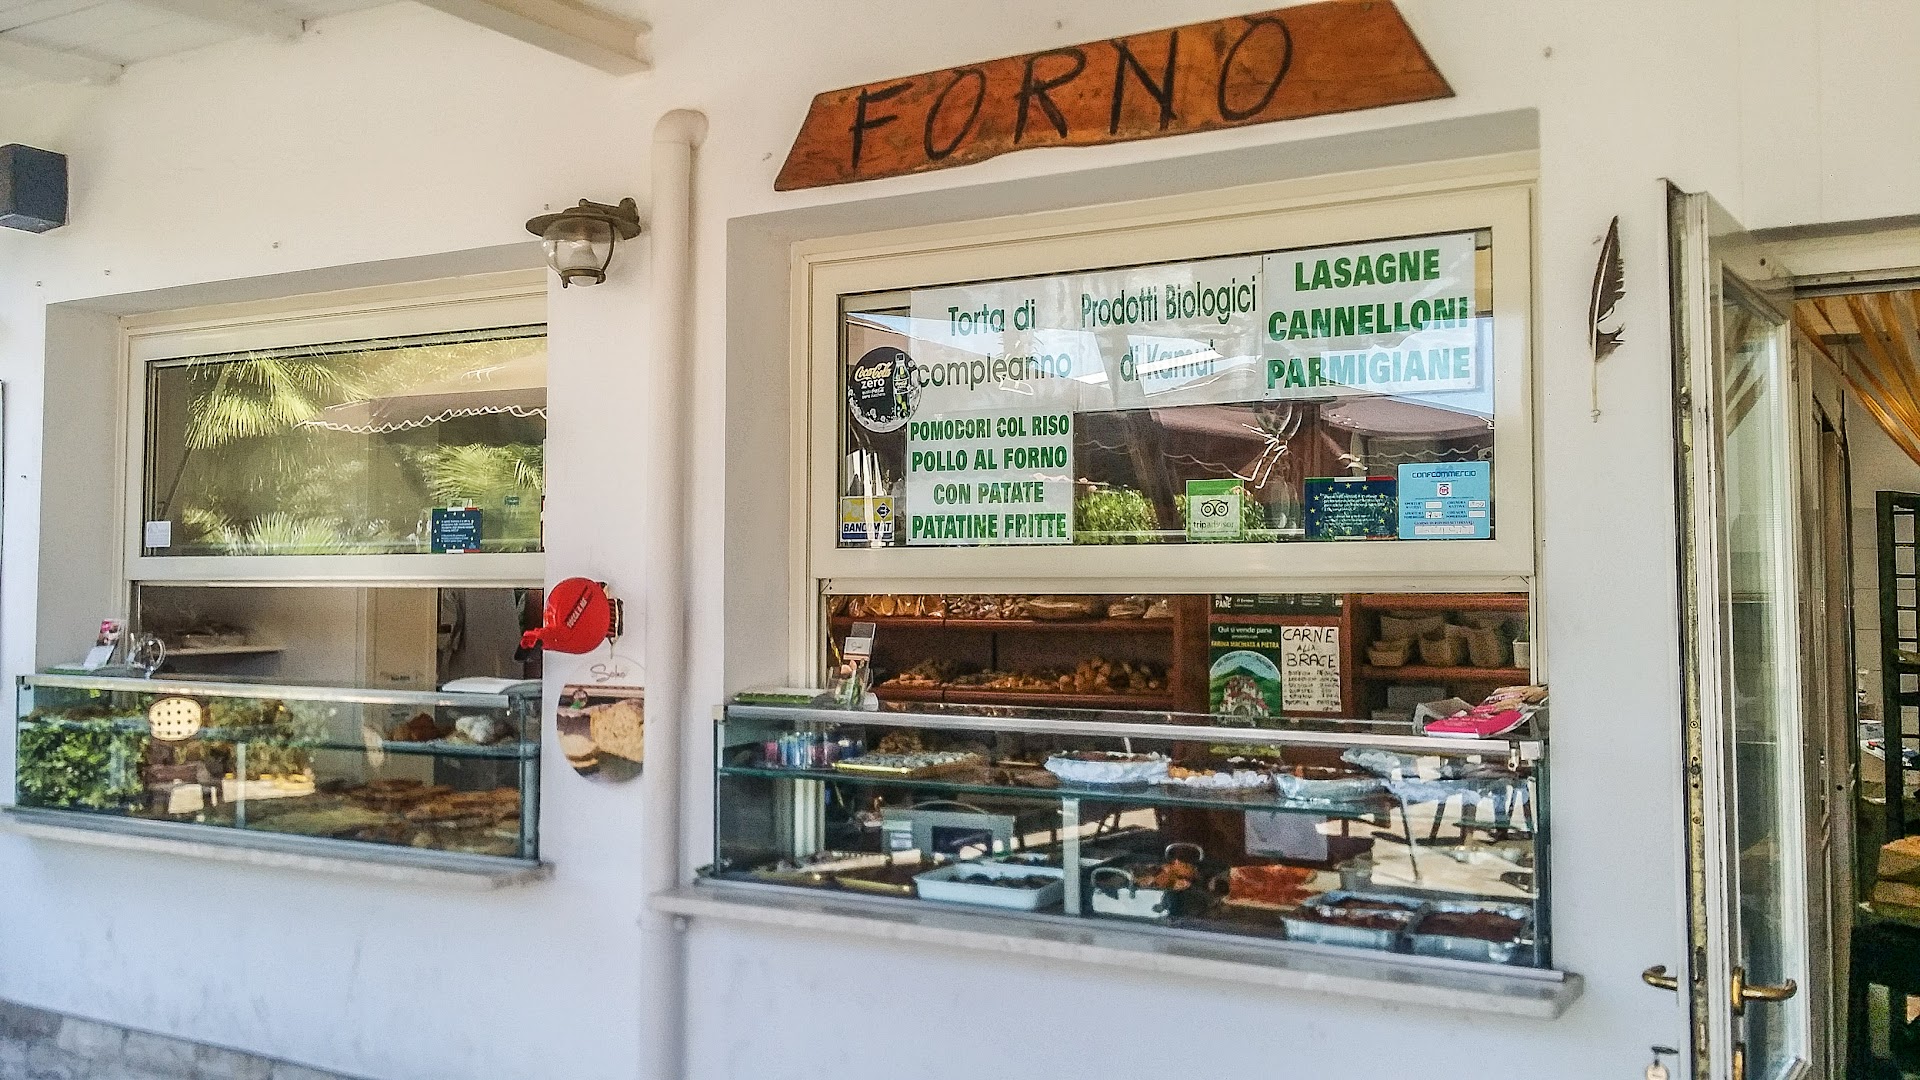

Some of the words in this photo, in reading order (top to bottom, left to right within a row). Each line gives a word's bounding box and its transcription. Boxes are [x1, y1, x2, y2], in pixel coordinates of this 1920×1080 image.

[849, 16, 1292, 170] FORNO
[1294, 249, 1440, 292] LASAGNE
[947, 304, 1005, 336] Torta
[1013, 299, 1036, 331] di
[1081, 286, 1158, 328] Prodotti
[1166, 275, 1256, 325] Biologici
[1268, 297, 1468, 342] CANNELLONI
[918, 351, 1072, 391] compleanno
[1120, 345, 1139, 382] di
[1267, 347, 1471, 390] PARMIGIANE
[861, 379, 885, 390] zero
[910, 418, 991, 442] POMODORI
[996, 416, 1027, 439] COL
[1032, 414, 1070, 436] RISO
[912, 450, 968, 473] POLLO
[973, 448, 998, 471] AL
[1004, 446, 1068, 470] FORNO
[933, 483, 971, 506] CON
[977, 481, 1045, 505] PATATE
[843, 522, 892, 533] BANCMAT
[912, 514, 999, 540] PATATINE
[1004, 513, 1067, 539] FRITTE
[1282, 626, 1335, 644] CARNE
[1285, 652, 1336, 669] BRACE
